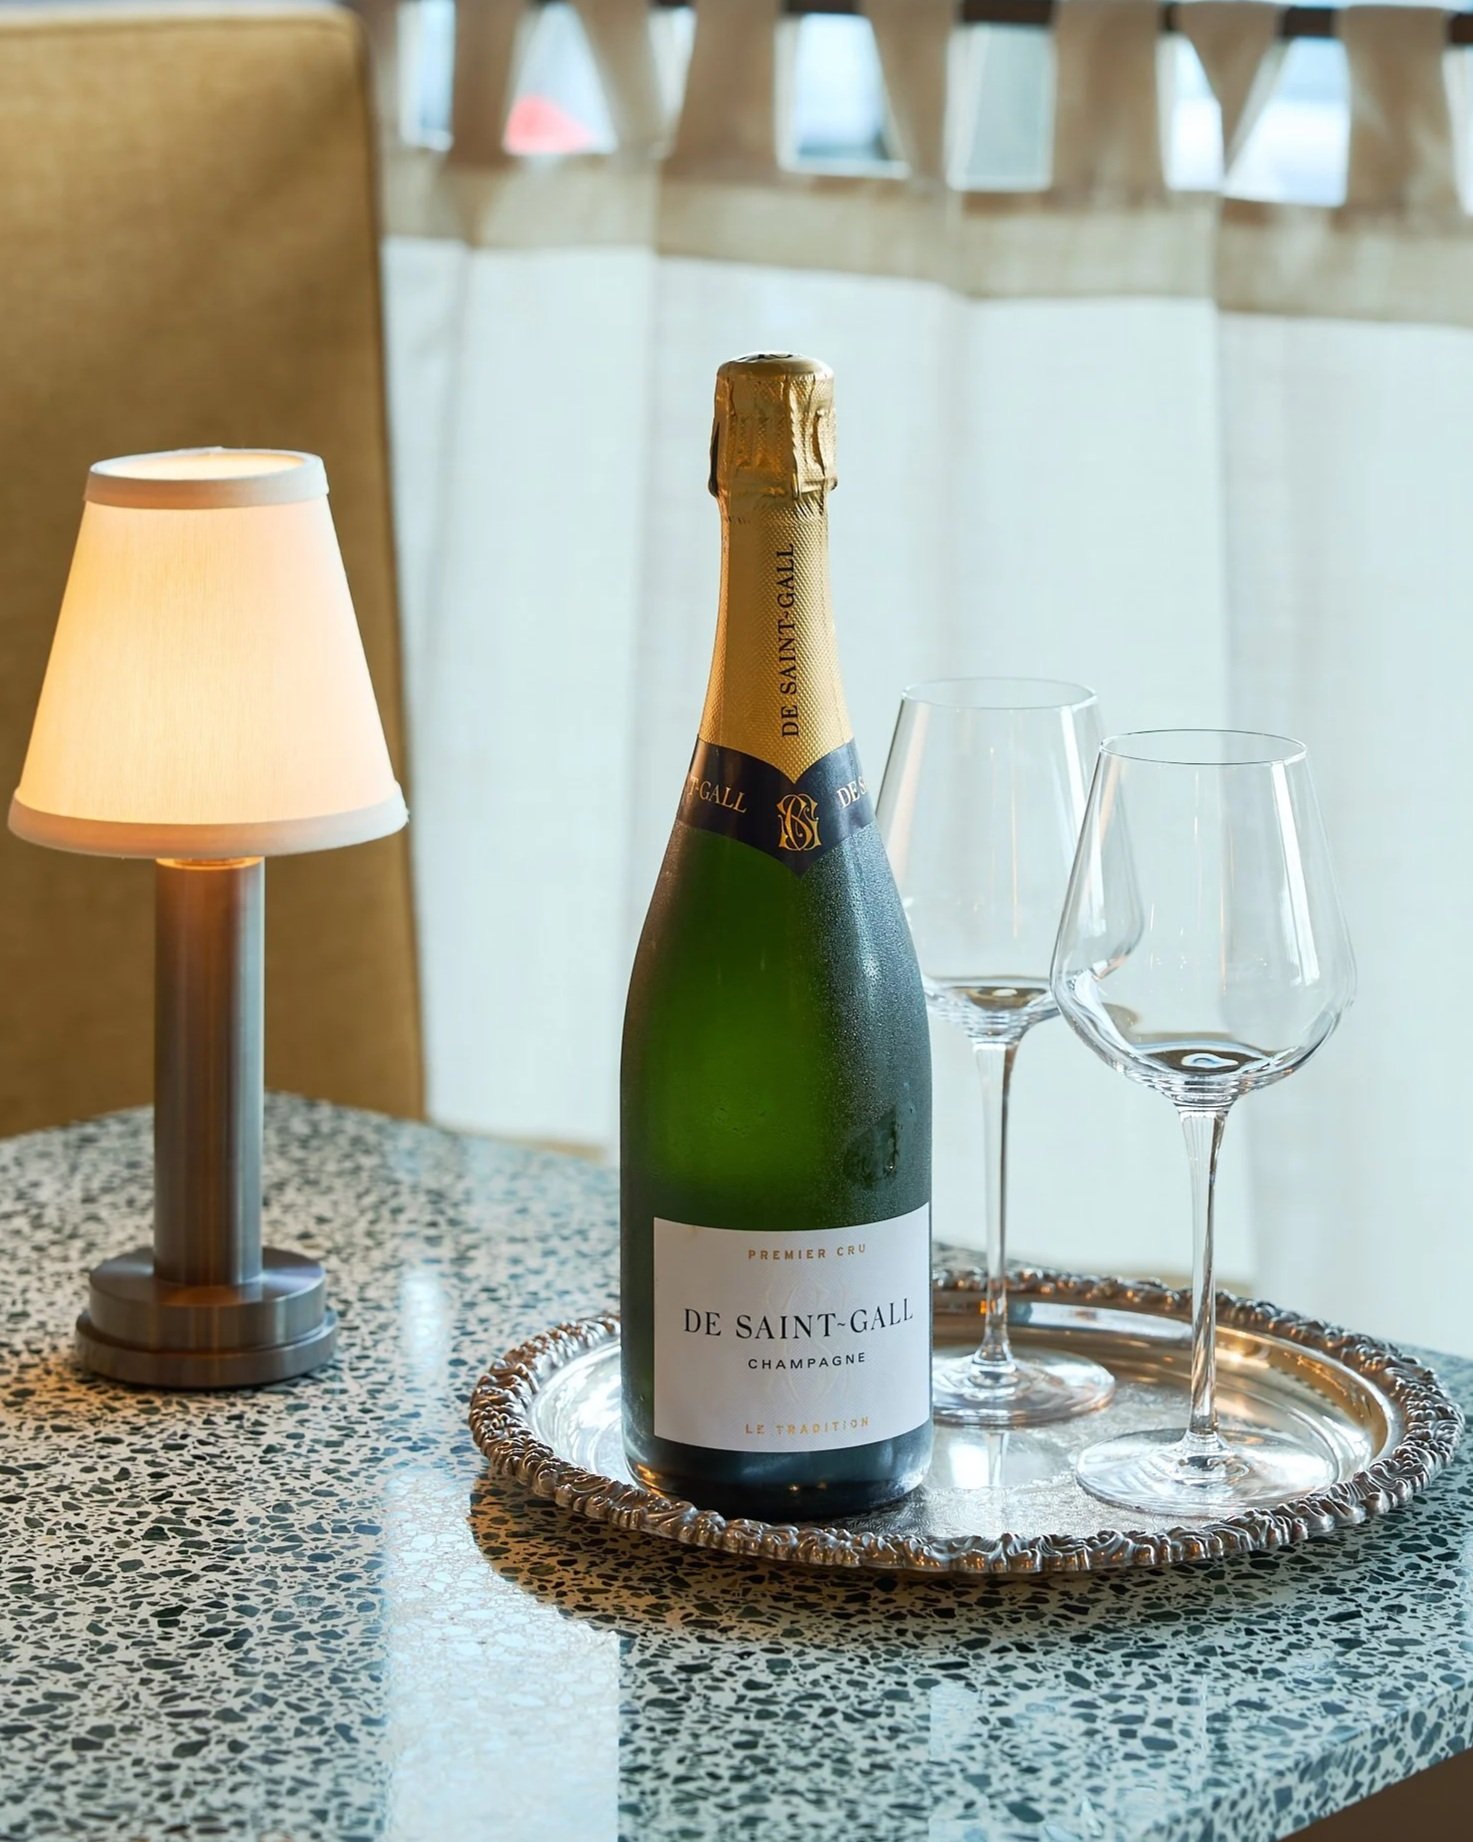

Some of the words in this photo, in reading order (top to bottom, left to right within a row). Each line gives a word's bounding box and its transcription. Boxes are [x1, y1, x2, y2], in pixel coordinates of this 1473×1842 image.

[781, 704, 799, 737] DE
[747, 1248, 827, 1260] PREMIER
[836, 1243, 866, 1257] CRU
[684, 1308, 722, 1336] DE
[747, 1352, 866, 1370] CHAMPAGNE
[744, 1423, 765, 1435] LE
[775, 1417, 869, 1435] TRADITION
